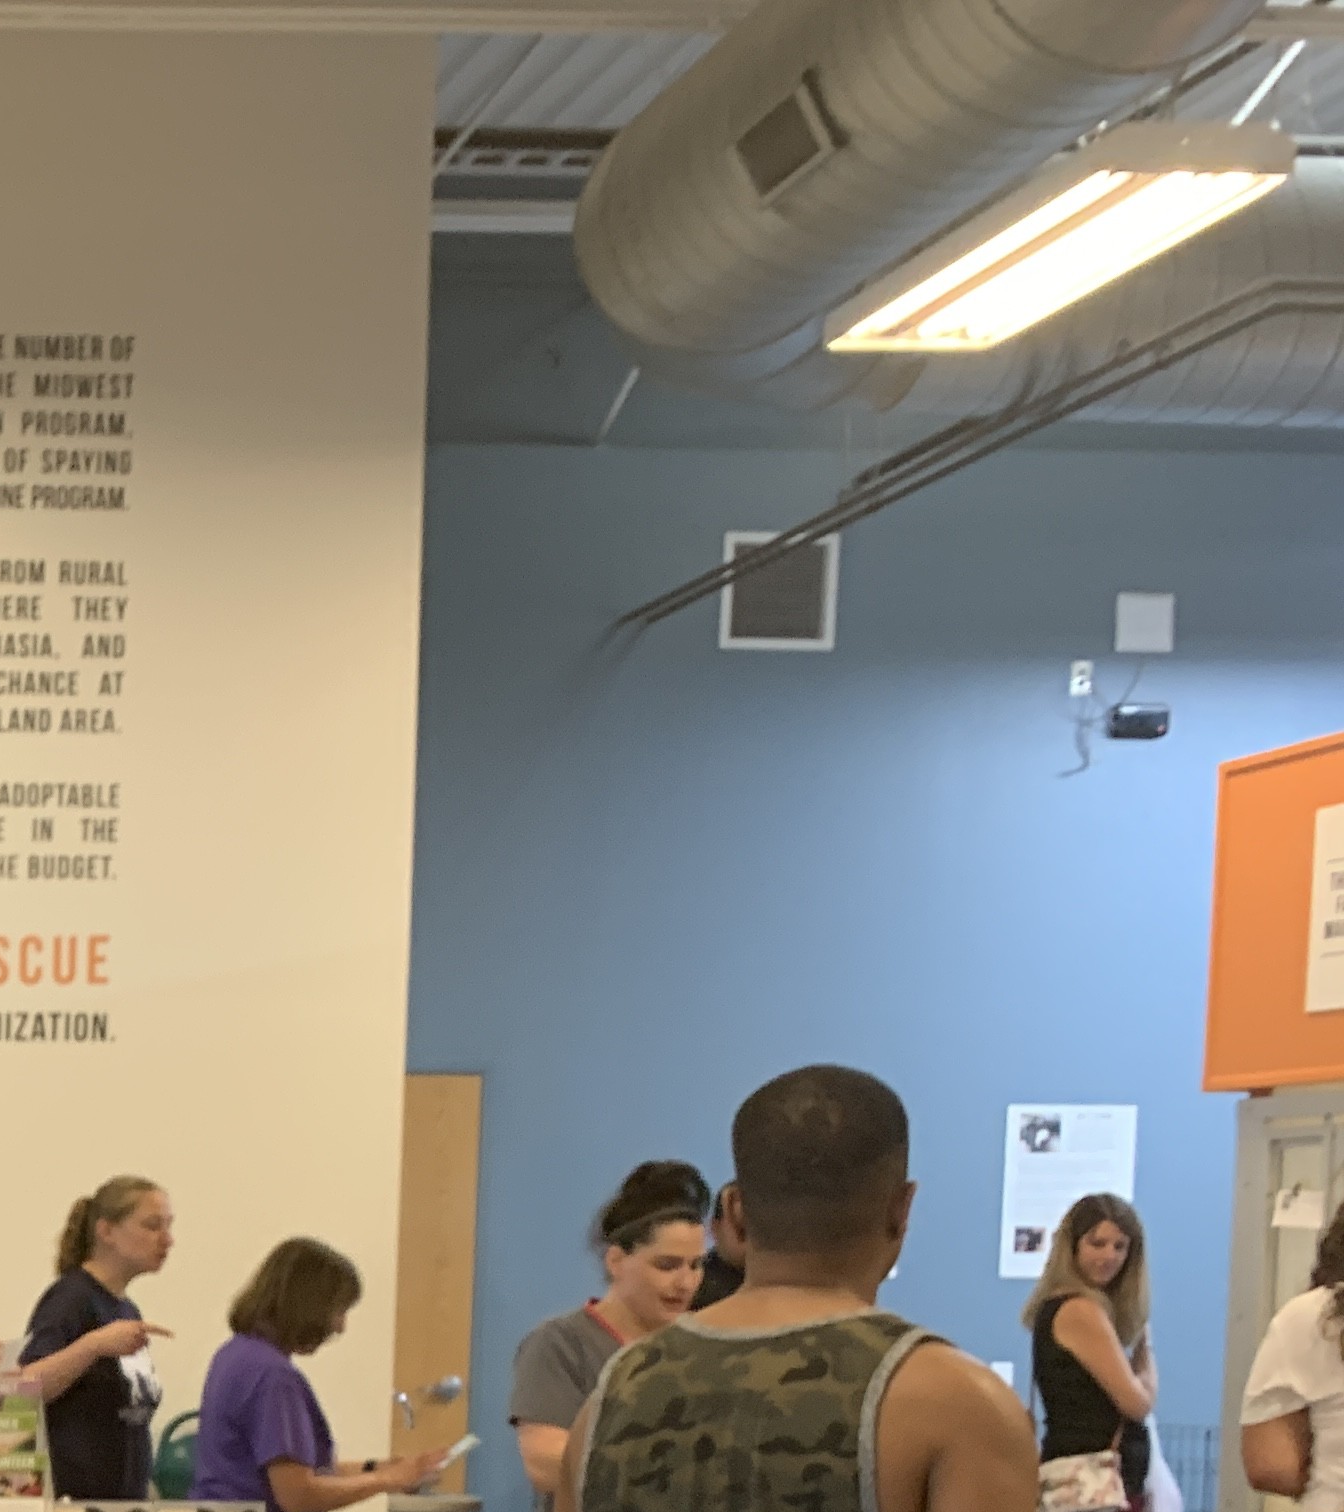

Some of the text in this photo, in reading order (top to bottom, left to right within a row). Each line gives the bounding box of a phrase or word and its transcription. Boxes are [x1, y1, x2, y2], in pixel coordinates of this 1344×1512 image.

[14, 334, 103, 361] NUMBER
[109, 335, 135, 361] OF
[34, 372, 134, 399] MIDWEST
[4, 447, 28, 473] OF
[41, 448, 132, 475] SPAYING
[58, 560, 128, 586] RURAL
[72, 596, 129, 621] THEY
[82, 634, 126, 659] AND
[98, 671, 125, 697] AT
[31, 817, 54, 842] IN
[81, 818, 119, 843] THE
[27, 854, 118, 881] BUDGET.
